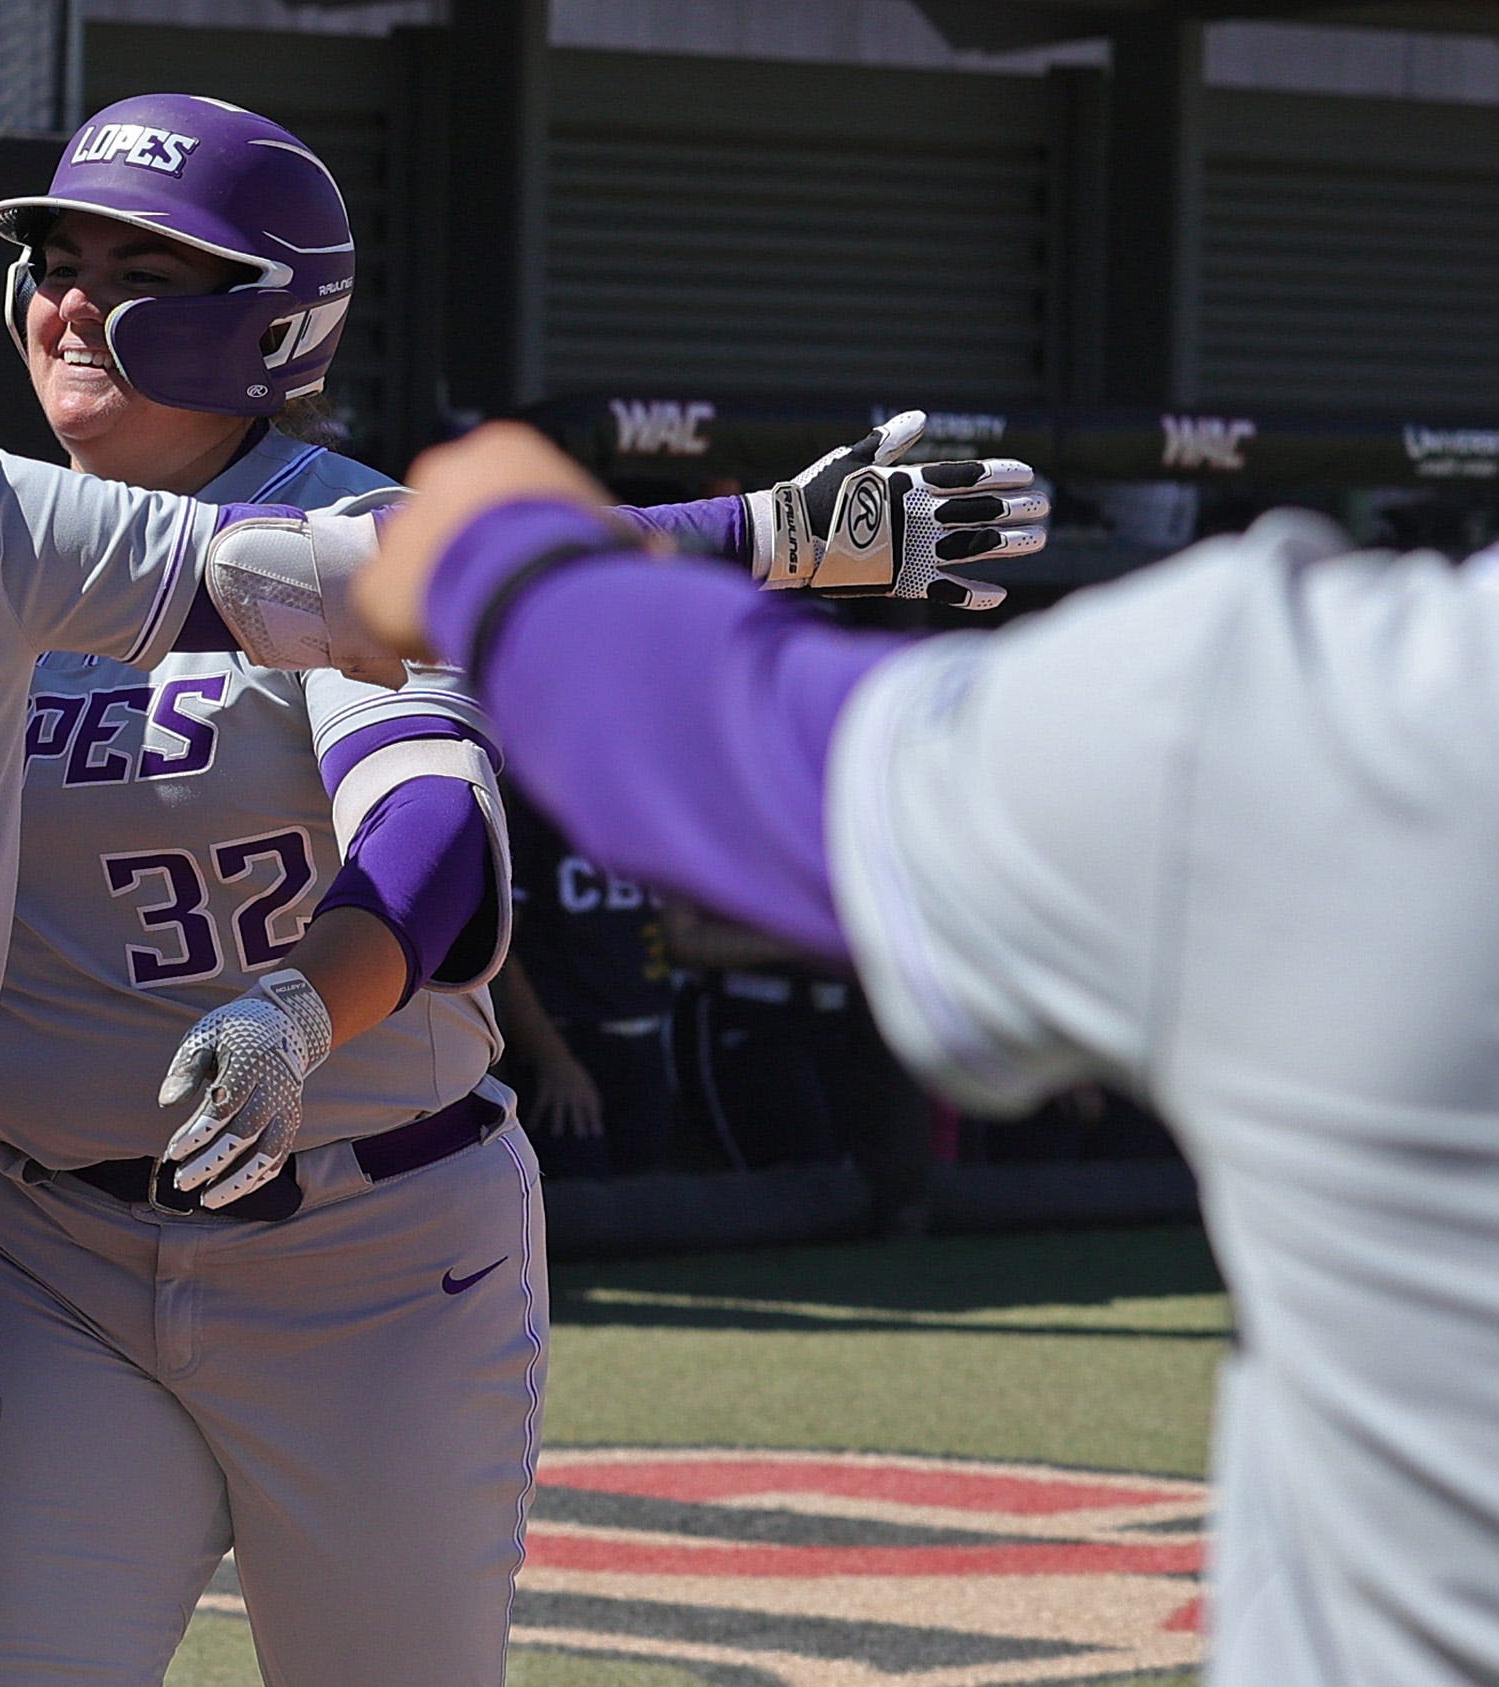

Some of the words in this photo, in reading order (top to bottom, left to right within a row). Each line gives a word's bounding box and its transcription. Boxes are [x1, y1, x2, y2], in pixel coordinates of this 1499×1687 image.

[70, 123, 199, 176] LOPES
[317, 276, 354, 297] RAWLING
[610, 399, 715, 455] WAC
[1160, 413, 1257, 470] WAC
[782, 490, 799, 575] RAWLINGS
[24, 669, 232, 788] PES
[100, 824, 318, 990] 32
